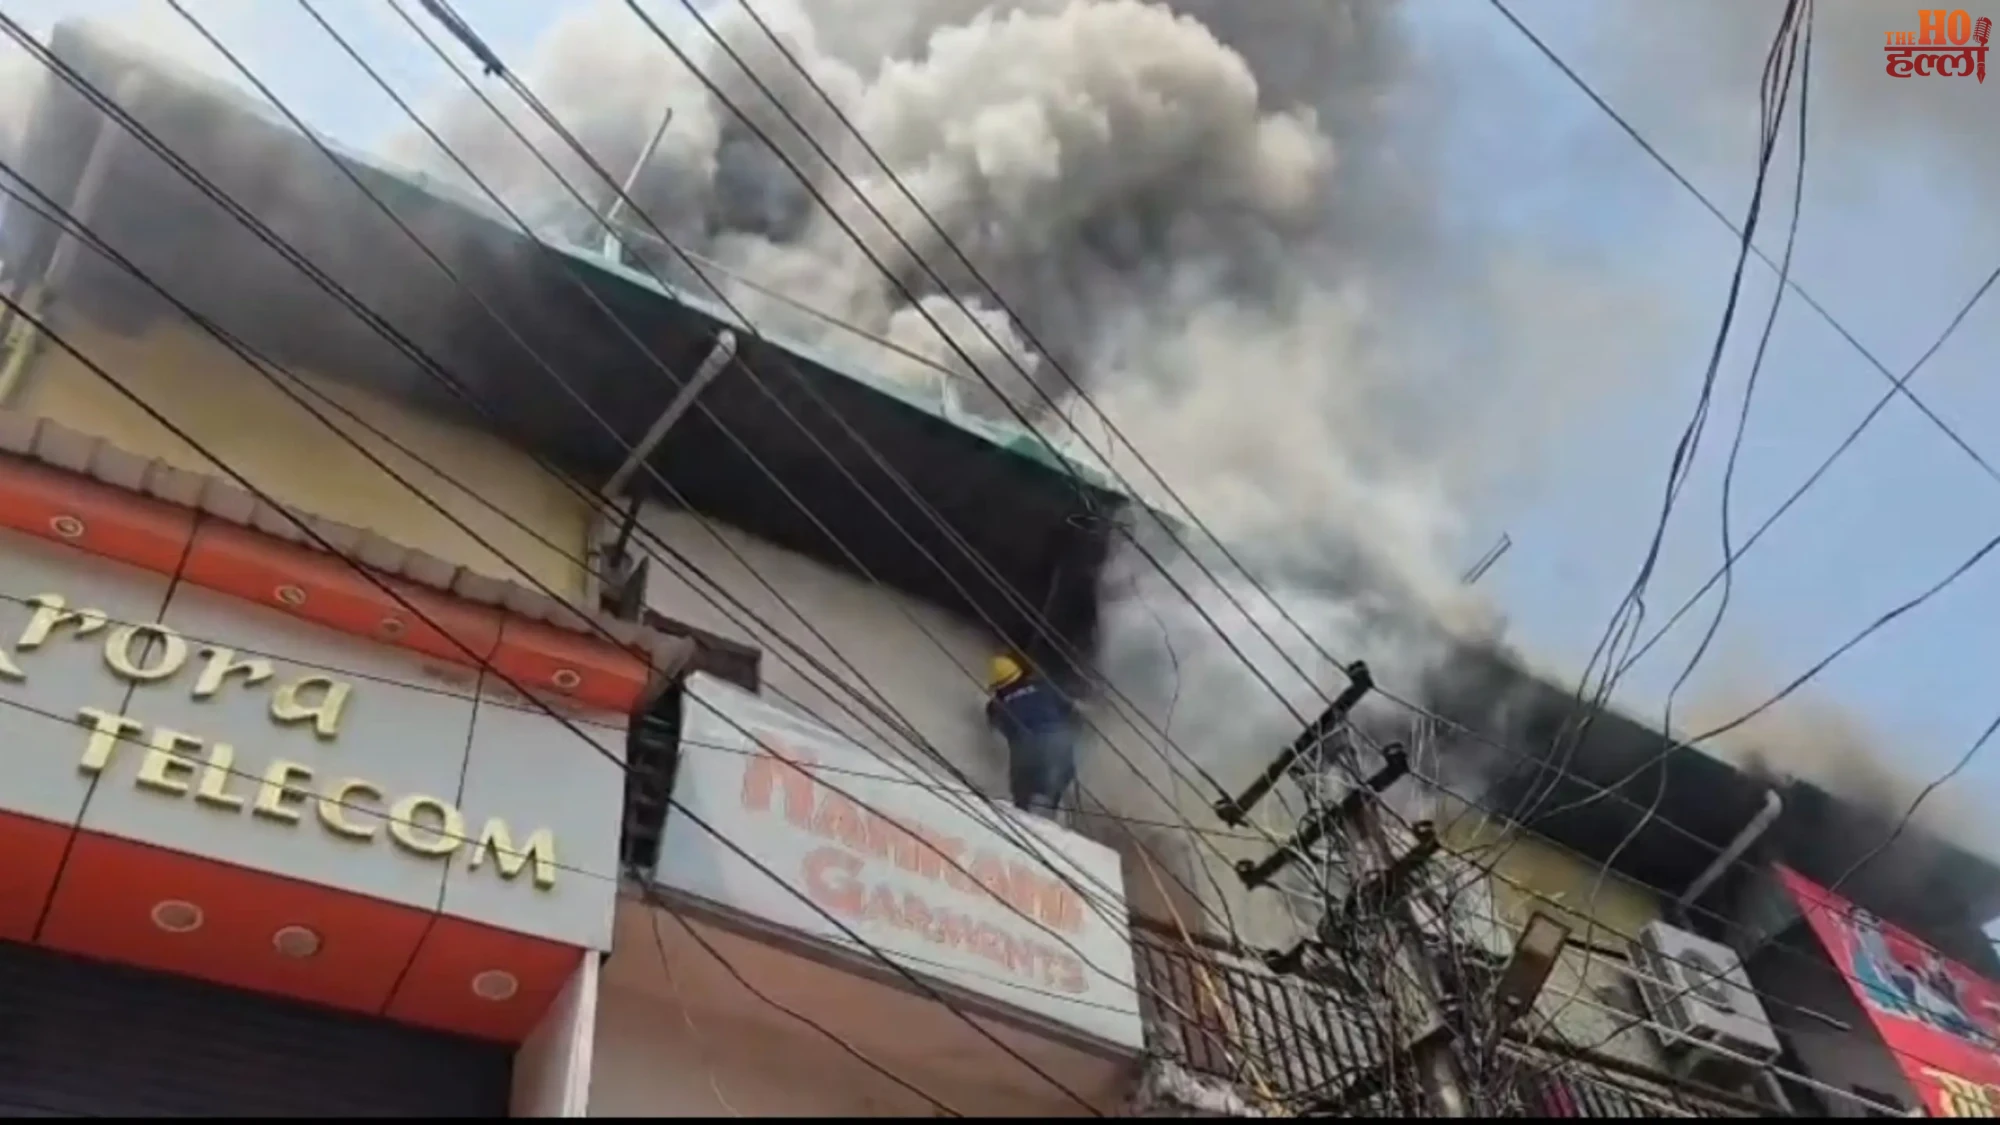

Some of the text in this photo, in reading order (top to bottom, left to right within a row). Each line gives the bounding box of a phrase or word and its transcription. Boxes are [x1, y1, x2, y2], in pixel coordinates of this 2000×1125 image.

[0, 593, 352, 742] rora
[76, 705, 557, 891] TELECOM
[803, 846, 1090, 995] GARMENTS
